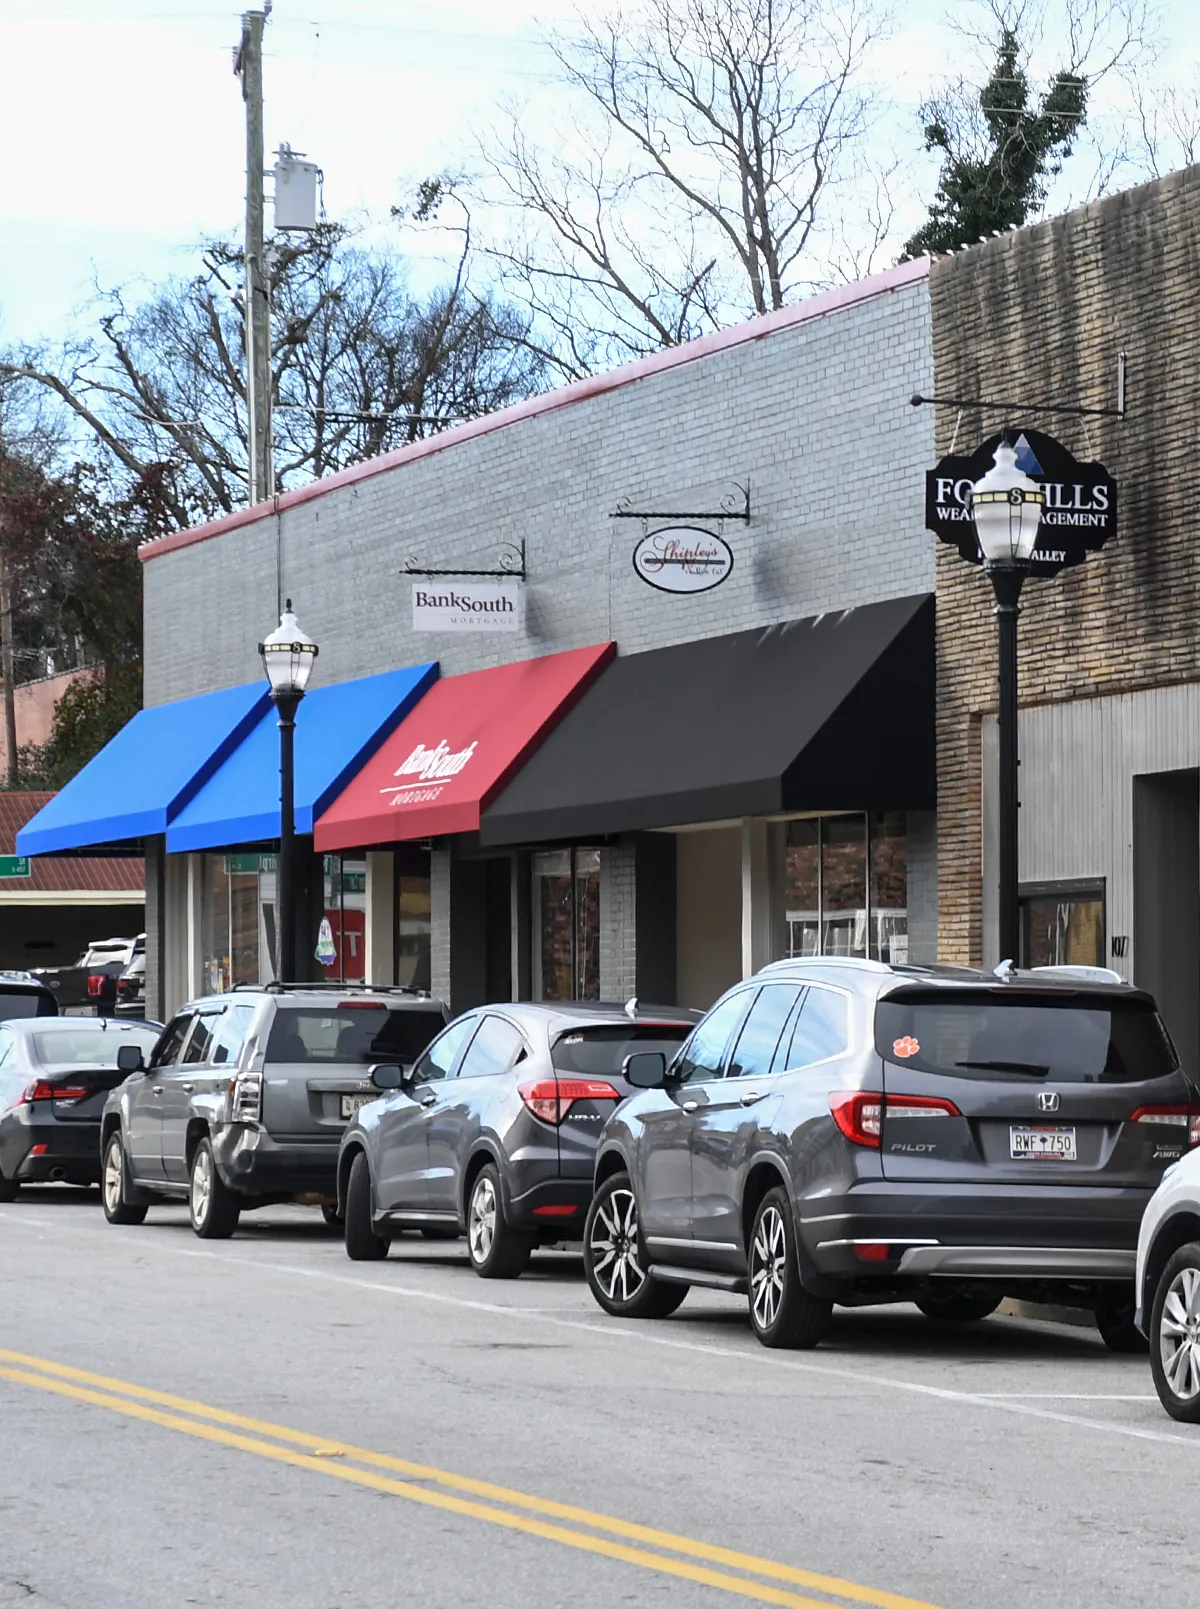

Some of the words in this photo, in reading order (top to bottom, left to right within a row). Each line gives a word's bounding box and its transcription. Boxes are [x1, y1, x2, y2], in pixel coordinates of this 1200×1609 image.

[415, 591, 514, 613] BankSouth
[450, 617, 514, 625] MORTGAGE
[394, 739, 478, 780] BankSouth
[891, 1143, 937, 1152] PILOT
[1015, 1134, 1037, 1150] RWF
[1049, 1135, 1071, 1151] 750
